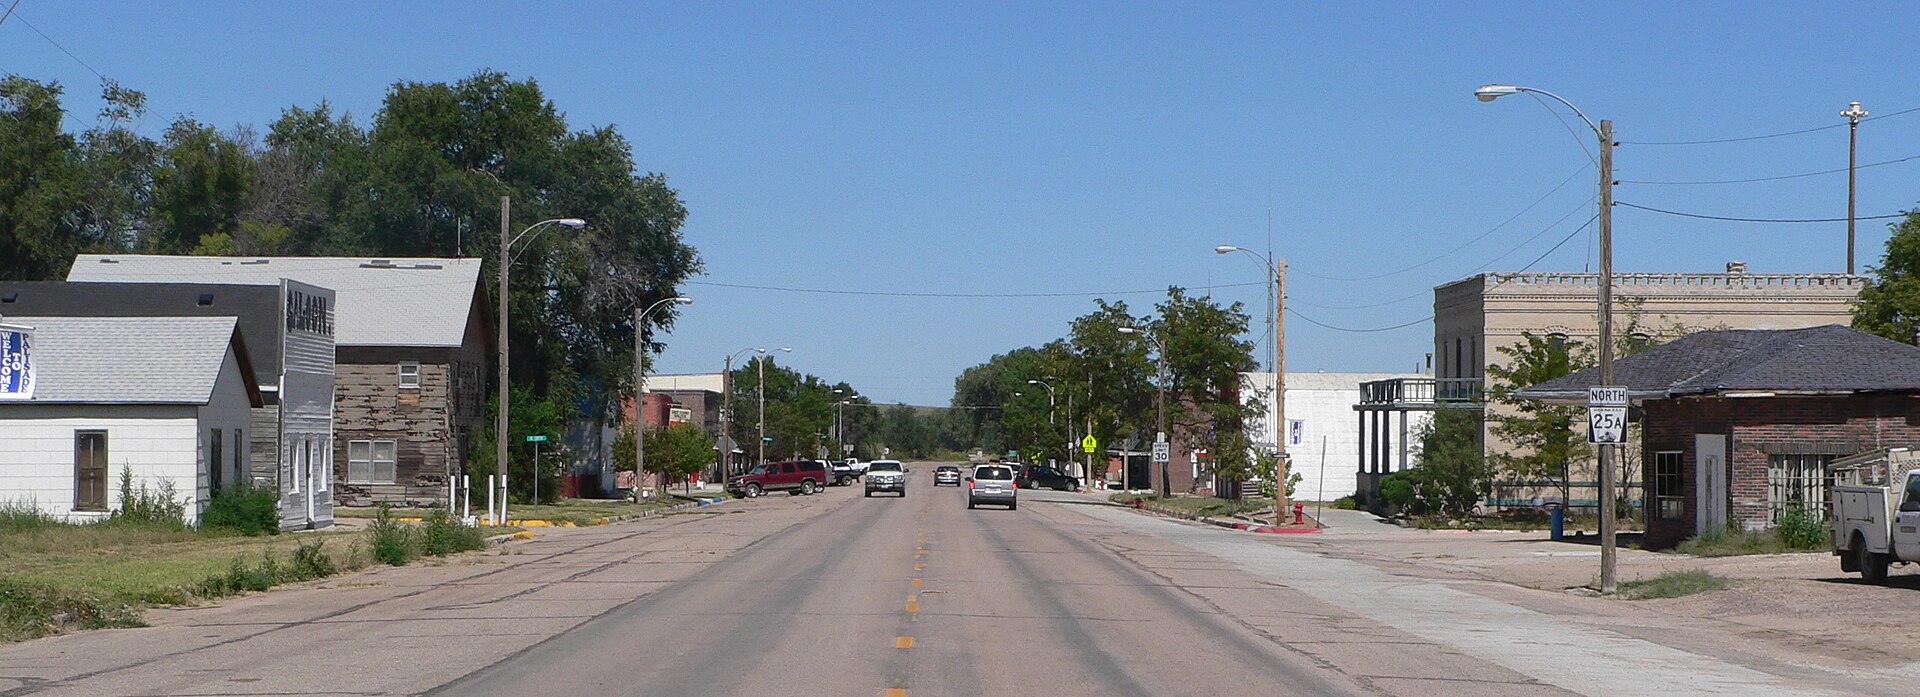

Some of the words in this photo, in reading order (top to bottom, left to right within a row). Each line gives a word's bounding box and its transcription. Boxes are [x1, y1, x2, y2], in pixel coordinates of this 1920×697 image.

[0, 332, 12, 392] WELCOME
[12, 352, 21, 371] TO
[21, 333, 31, 393] PALISADE
[1591, 390, 1625, 401] NORTH
[1593, 413, 1622, 429] 25A
[1155, 452, 1167, 460] 30
